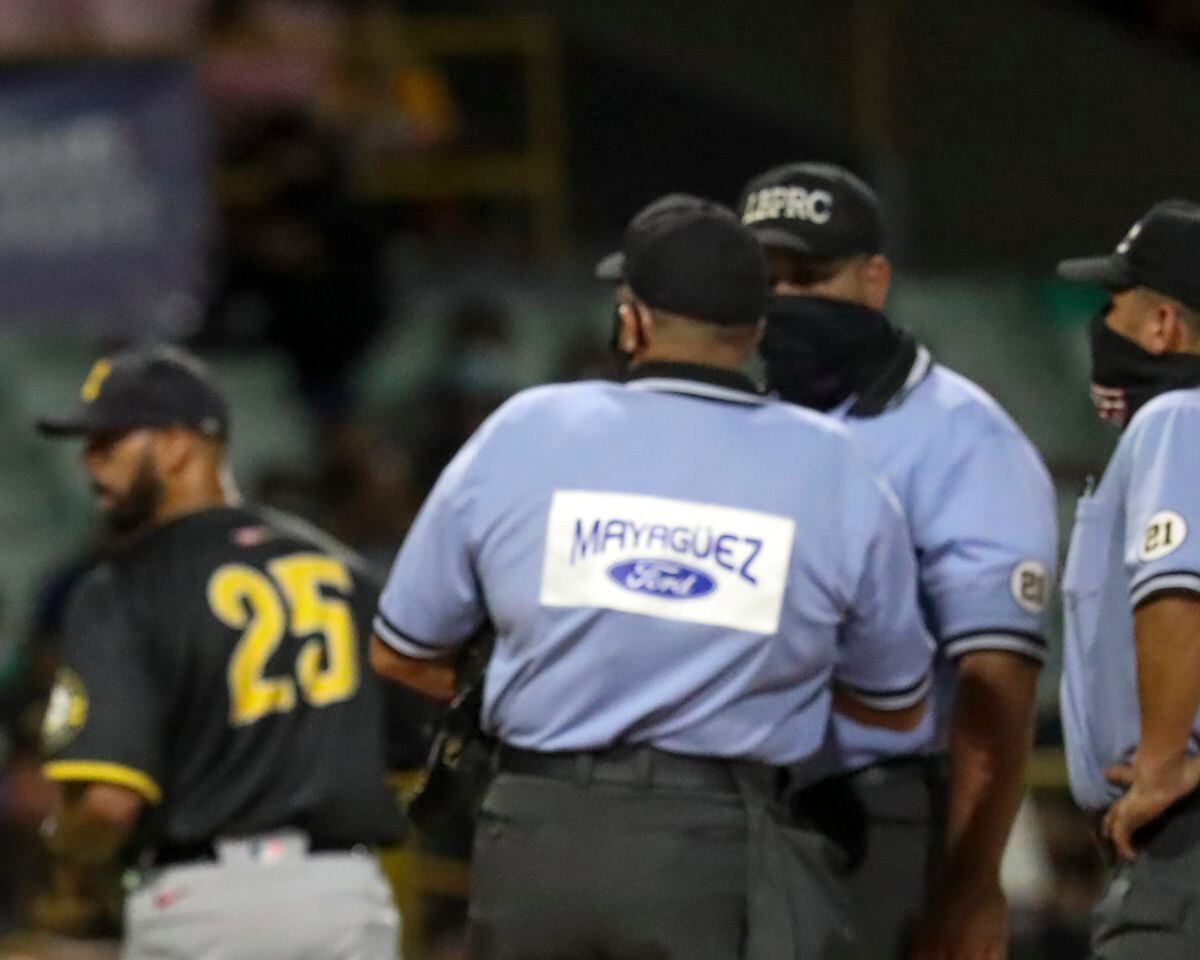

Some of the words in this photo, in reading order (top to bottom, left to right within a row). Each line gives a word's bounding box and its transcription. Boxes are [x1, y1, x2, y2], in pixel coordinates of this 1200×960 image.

[1144, 520, 1172, 553] 21
[623, 561, 699, 597] Ford
[205, 553, 360, 727] 25
